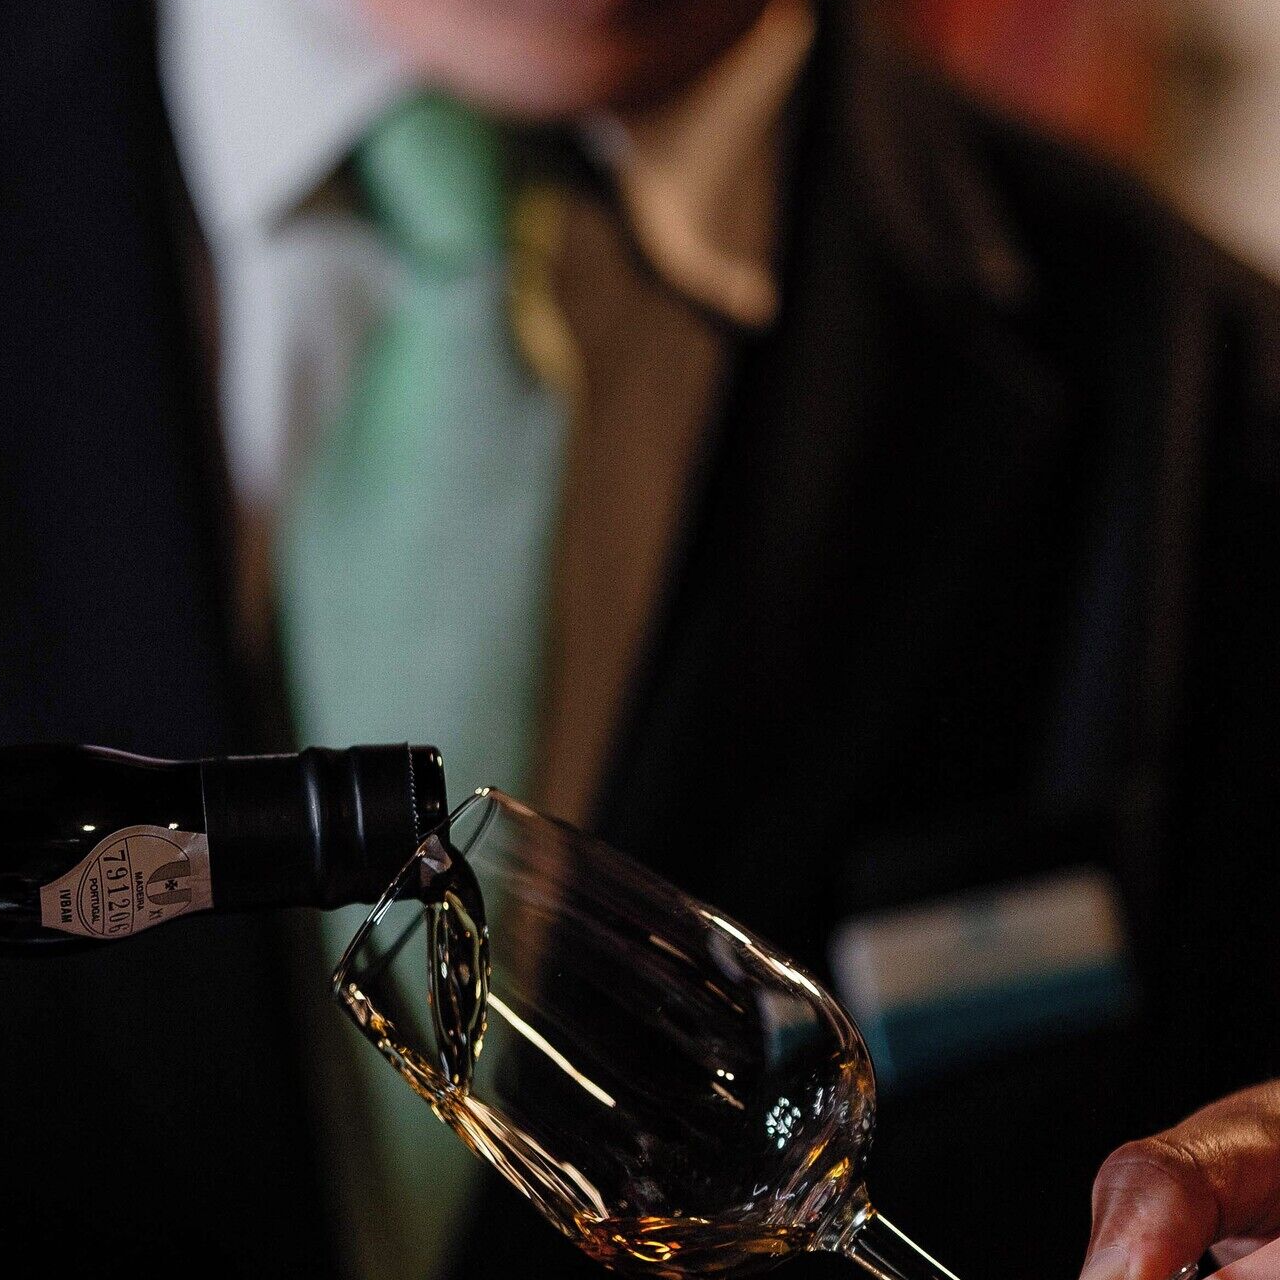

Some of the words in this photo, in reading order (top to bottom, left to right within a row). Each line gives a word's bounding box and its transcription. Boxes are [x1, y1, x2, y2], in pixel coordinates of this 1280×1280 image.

[59, 888, 72, 924] IVBAM
[102, 849, 131, 934] 791206
[133, 870, 145, 912] MADEIRA
